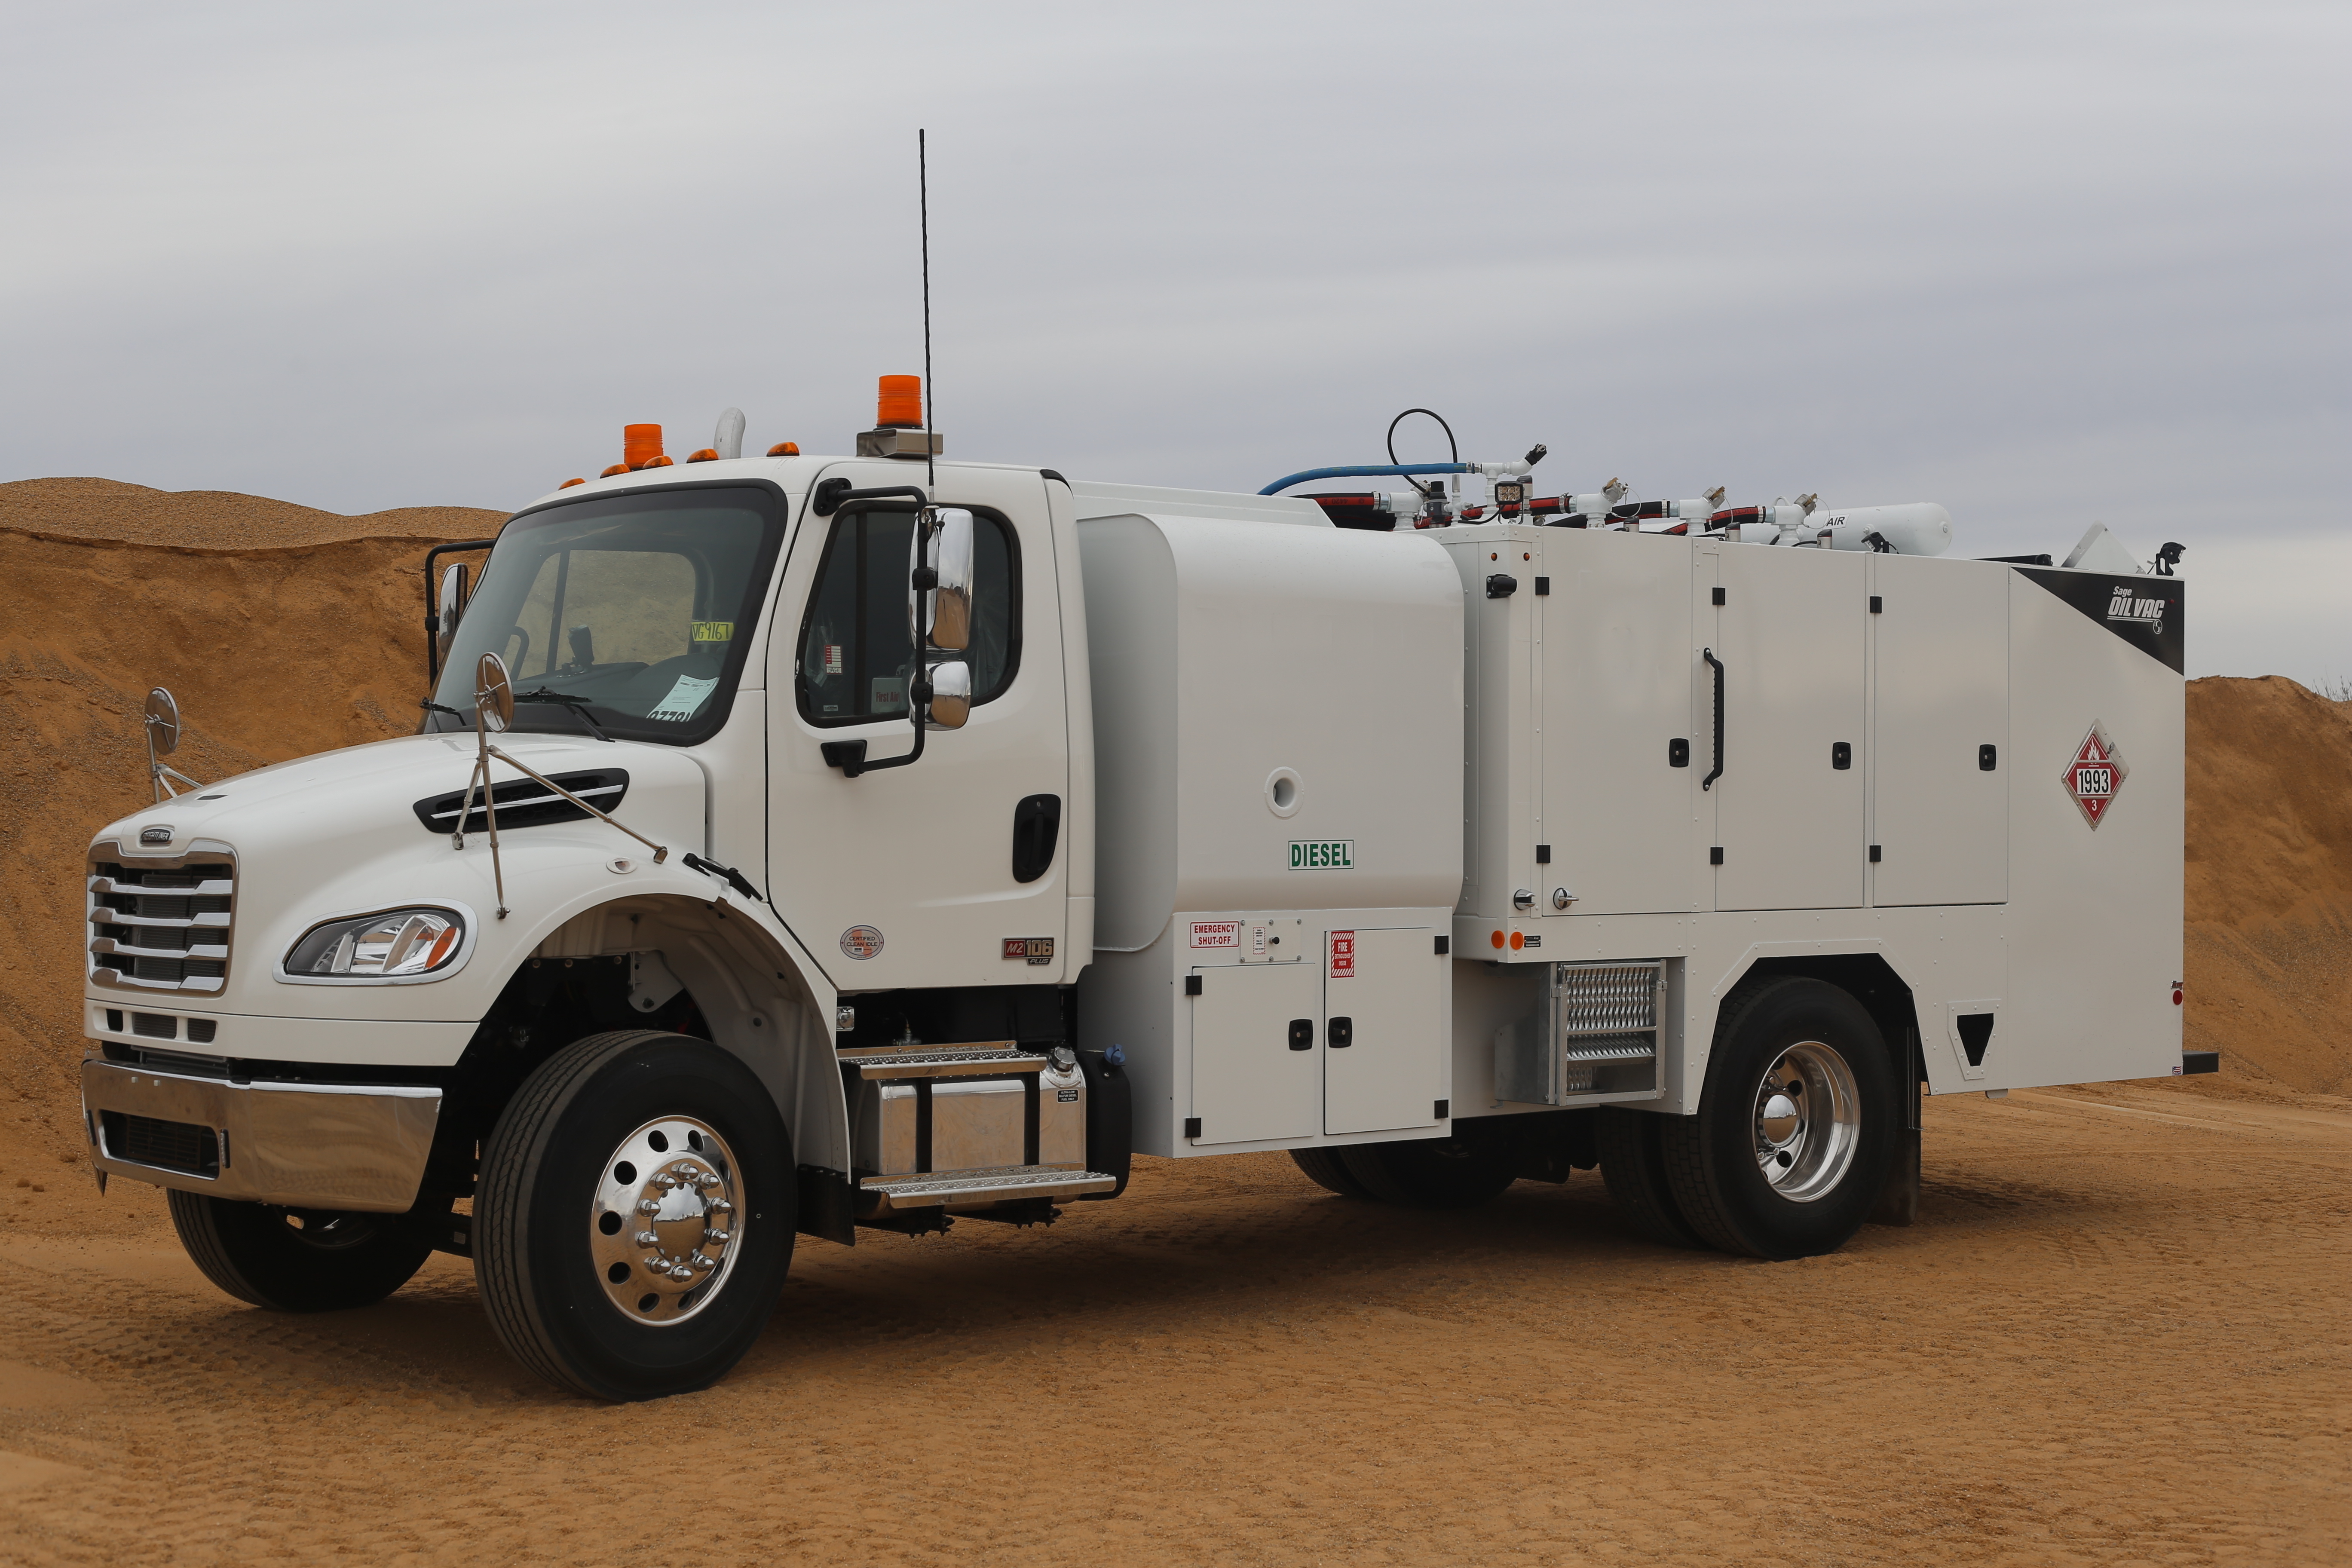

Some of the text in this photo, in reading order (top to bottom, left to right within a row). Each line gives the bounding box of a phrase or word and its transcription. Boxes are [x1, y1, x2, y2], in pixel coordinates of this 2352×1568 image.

[1724, 507, 1757, 517] SUCTION
[1826, 517, 1845, 527] AIR
[2113, 586, 2132, 597] Sage
[2108, 596, 2165, 618] OIL VAC
[876, 692, 889, 702] First
[2079, 770, 2109, 793] 1993
[2092, 799, 2097, 811] 3
[1292, 843, 1351, 867] DIESEL
[1194, 924, 1235, 934] EMERGENCY
[1198, 936, 1231, 945] SHUT-OFF
[1007, 940, 1053, 956] M2 106
[1338, 942, 1348, 952] FIRE
